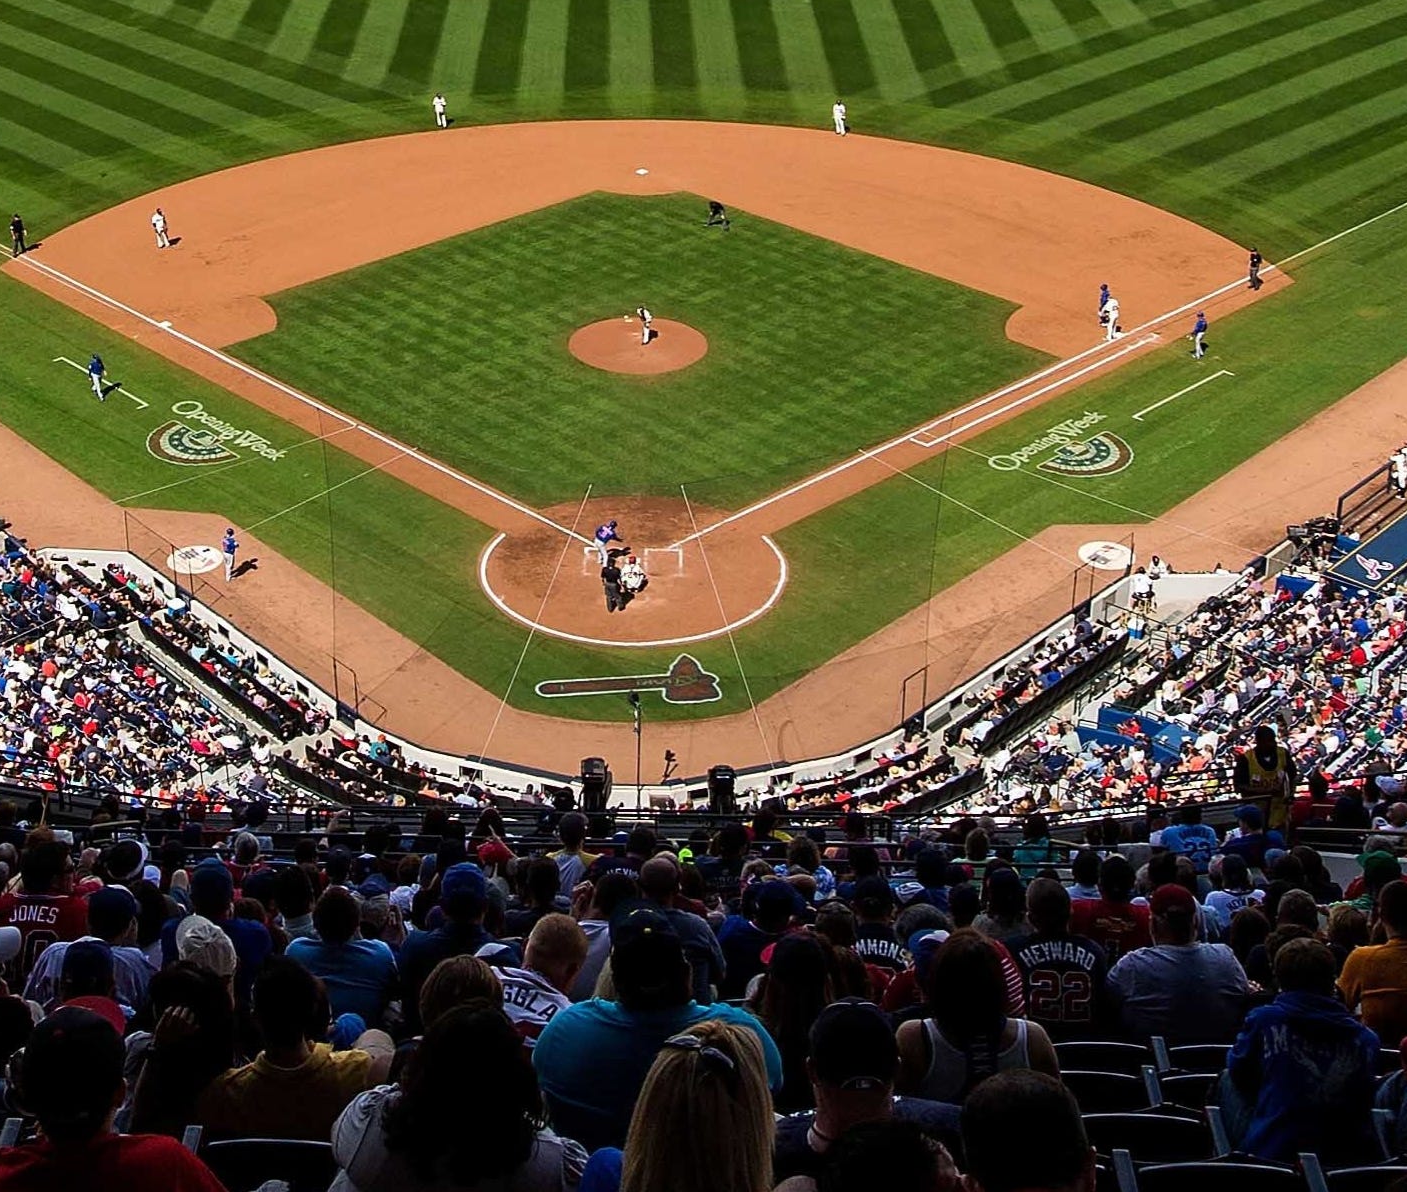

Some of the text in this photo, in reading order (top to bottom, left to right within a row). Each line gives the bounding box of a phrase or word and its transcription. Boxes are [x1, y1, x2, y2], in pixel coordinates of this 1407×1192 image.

[171, 400, 288, 462] Opening Week
[988, 410, 1108, 470] Opening Week
[9, 904, 61, 925] JONES
[853, 939, 908, 964] MMONS
[1019, 940, 1096, 971] HEYWARD
[502, 983, 559, 1021] GGLA
[1029, 969, 1092, 1022] 22
